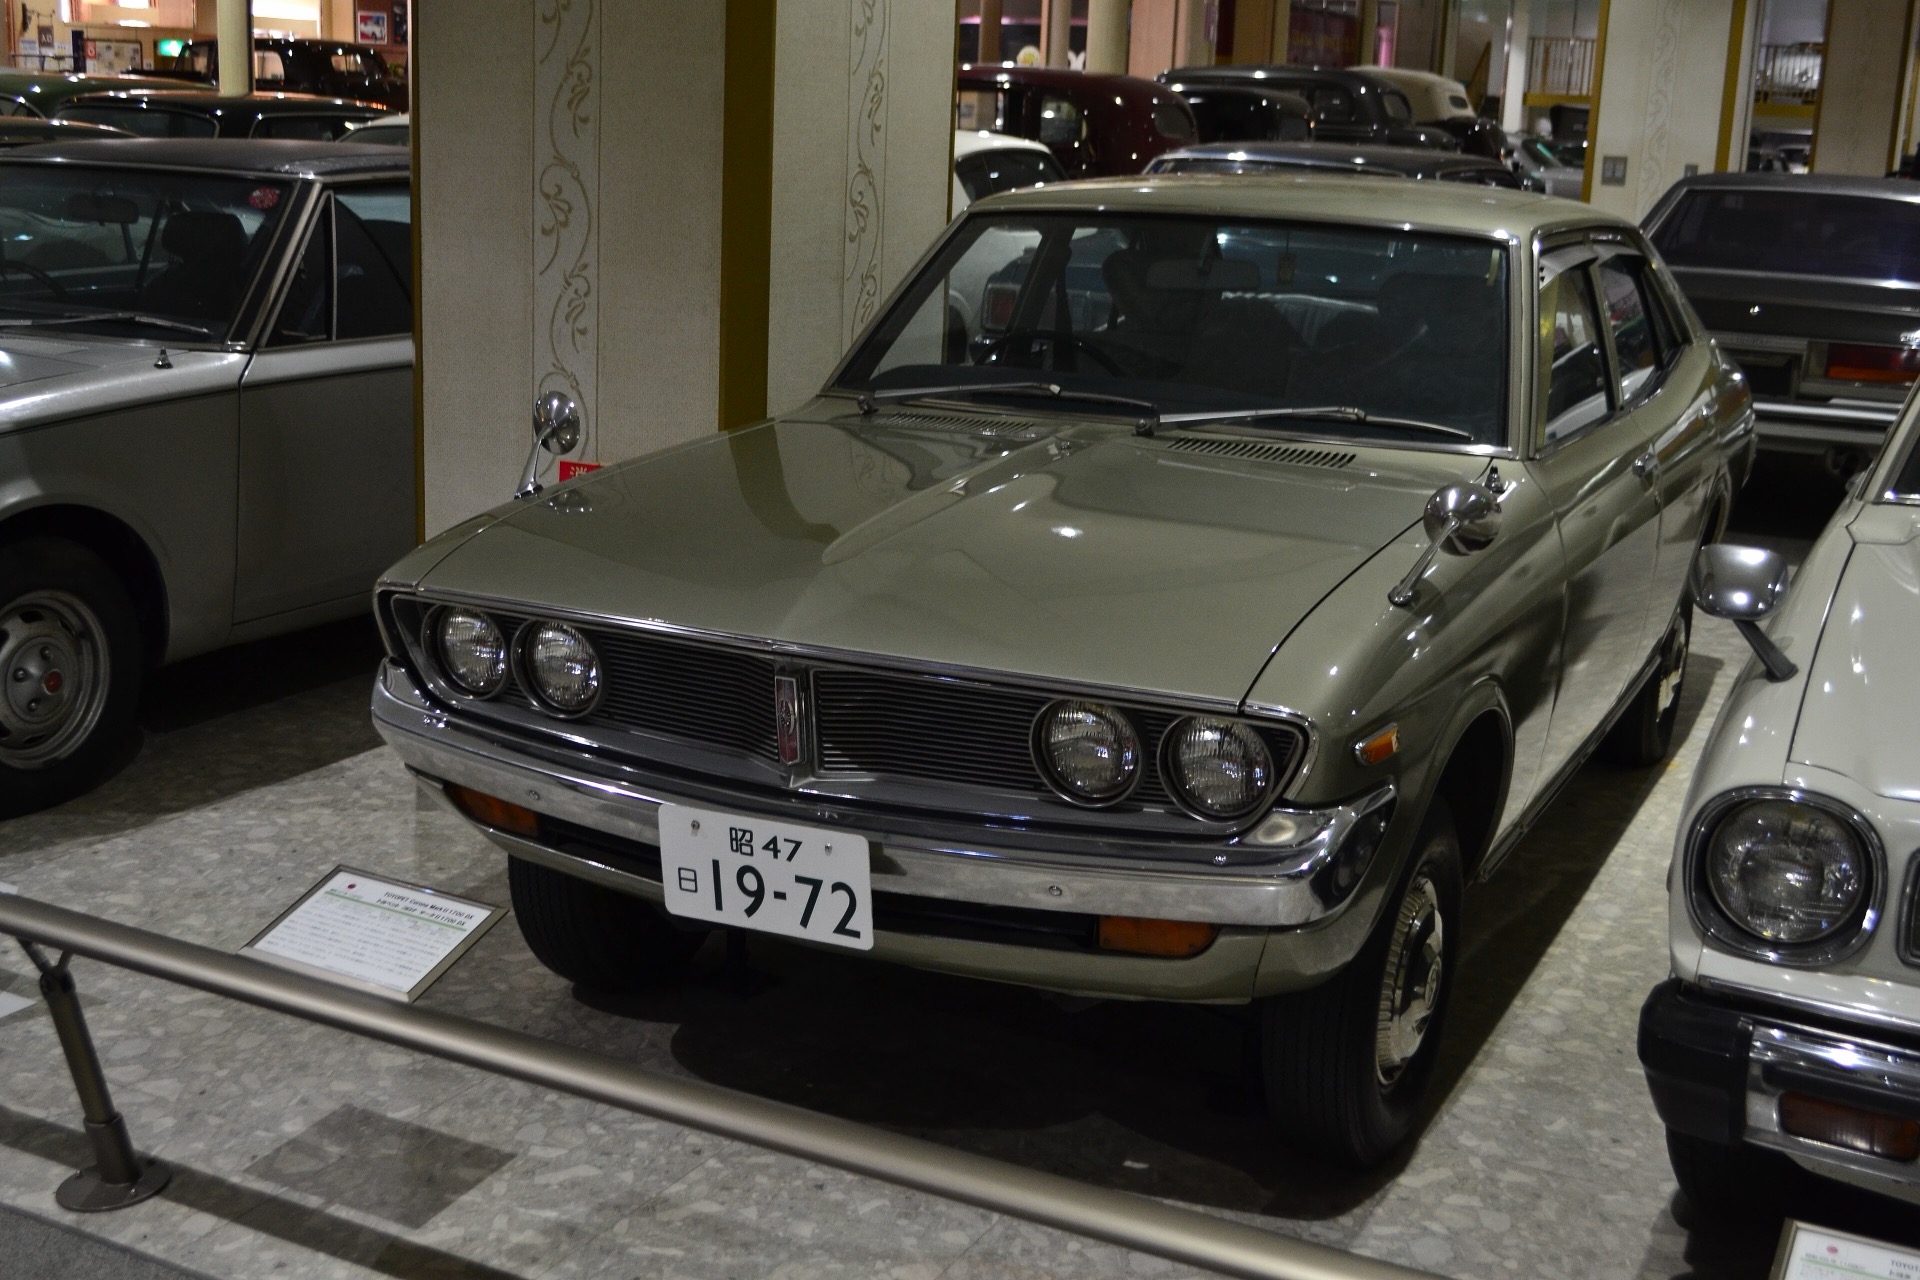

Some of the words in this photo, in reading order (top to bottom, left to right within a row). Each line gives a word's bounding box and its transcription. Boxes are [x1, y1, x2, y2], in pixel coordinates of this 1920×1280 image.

[729, 826, 754, 857] 昭
[761, 835, 803, 863] 47
[384, 892, 409, 902] TOYOPET
[410, 899, 429, 907] Corona
[449, 909, 465, 917] 1700
[677, 866, 698, 893] 日
[711, 858, 861, 940] 19-72
[1890, 1259, 1920, 1271] TOYOT
